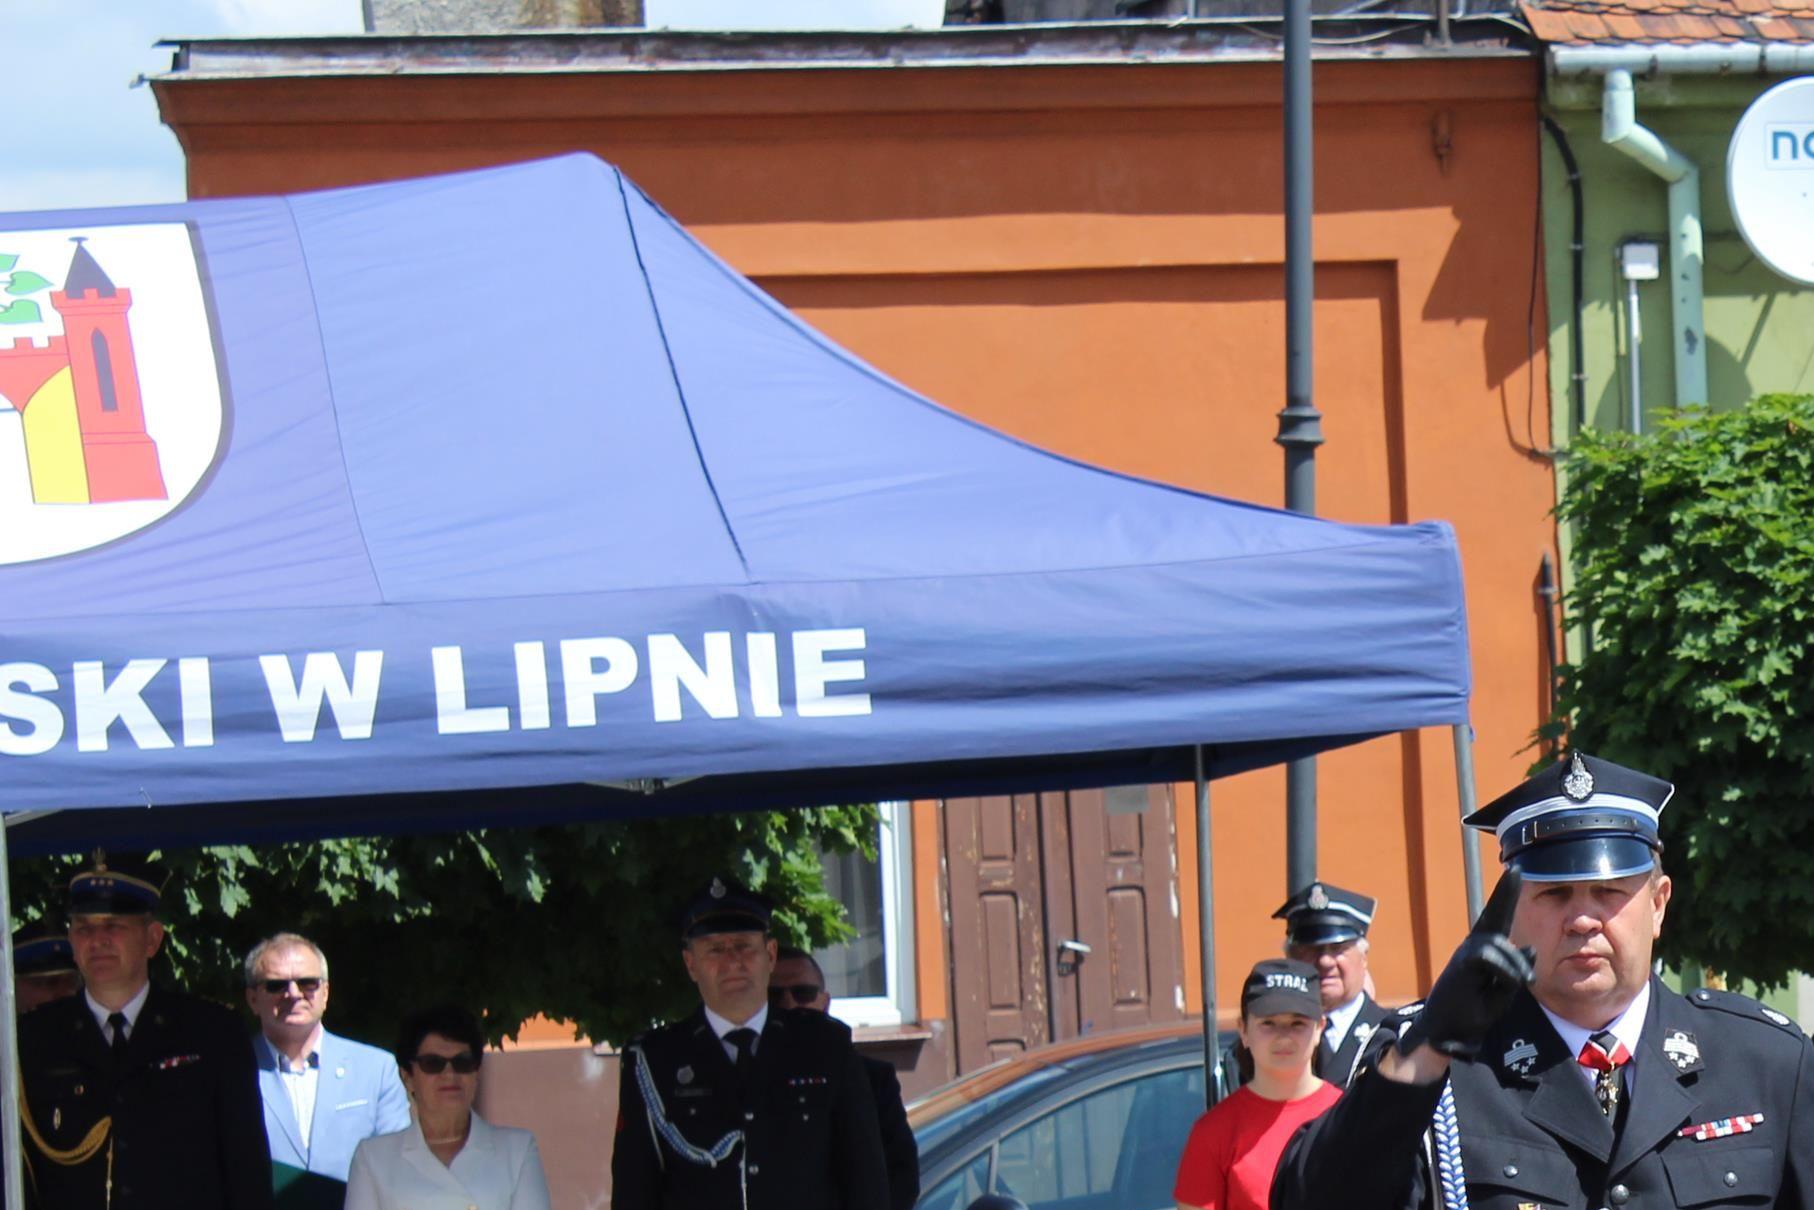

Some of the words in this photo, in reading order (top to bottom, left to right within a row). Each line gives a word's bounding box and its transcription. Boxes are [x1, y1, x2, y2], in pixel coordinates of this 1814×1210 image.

[0, 657, 214, 756] SKI
[259, 649, 385, 743] W
[430, 628, 874, 736] LIPNIE
